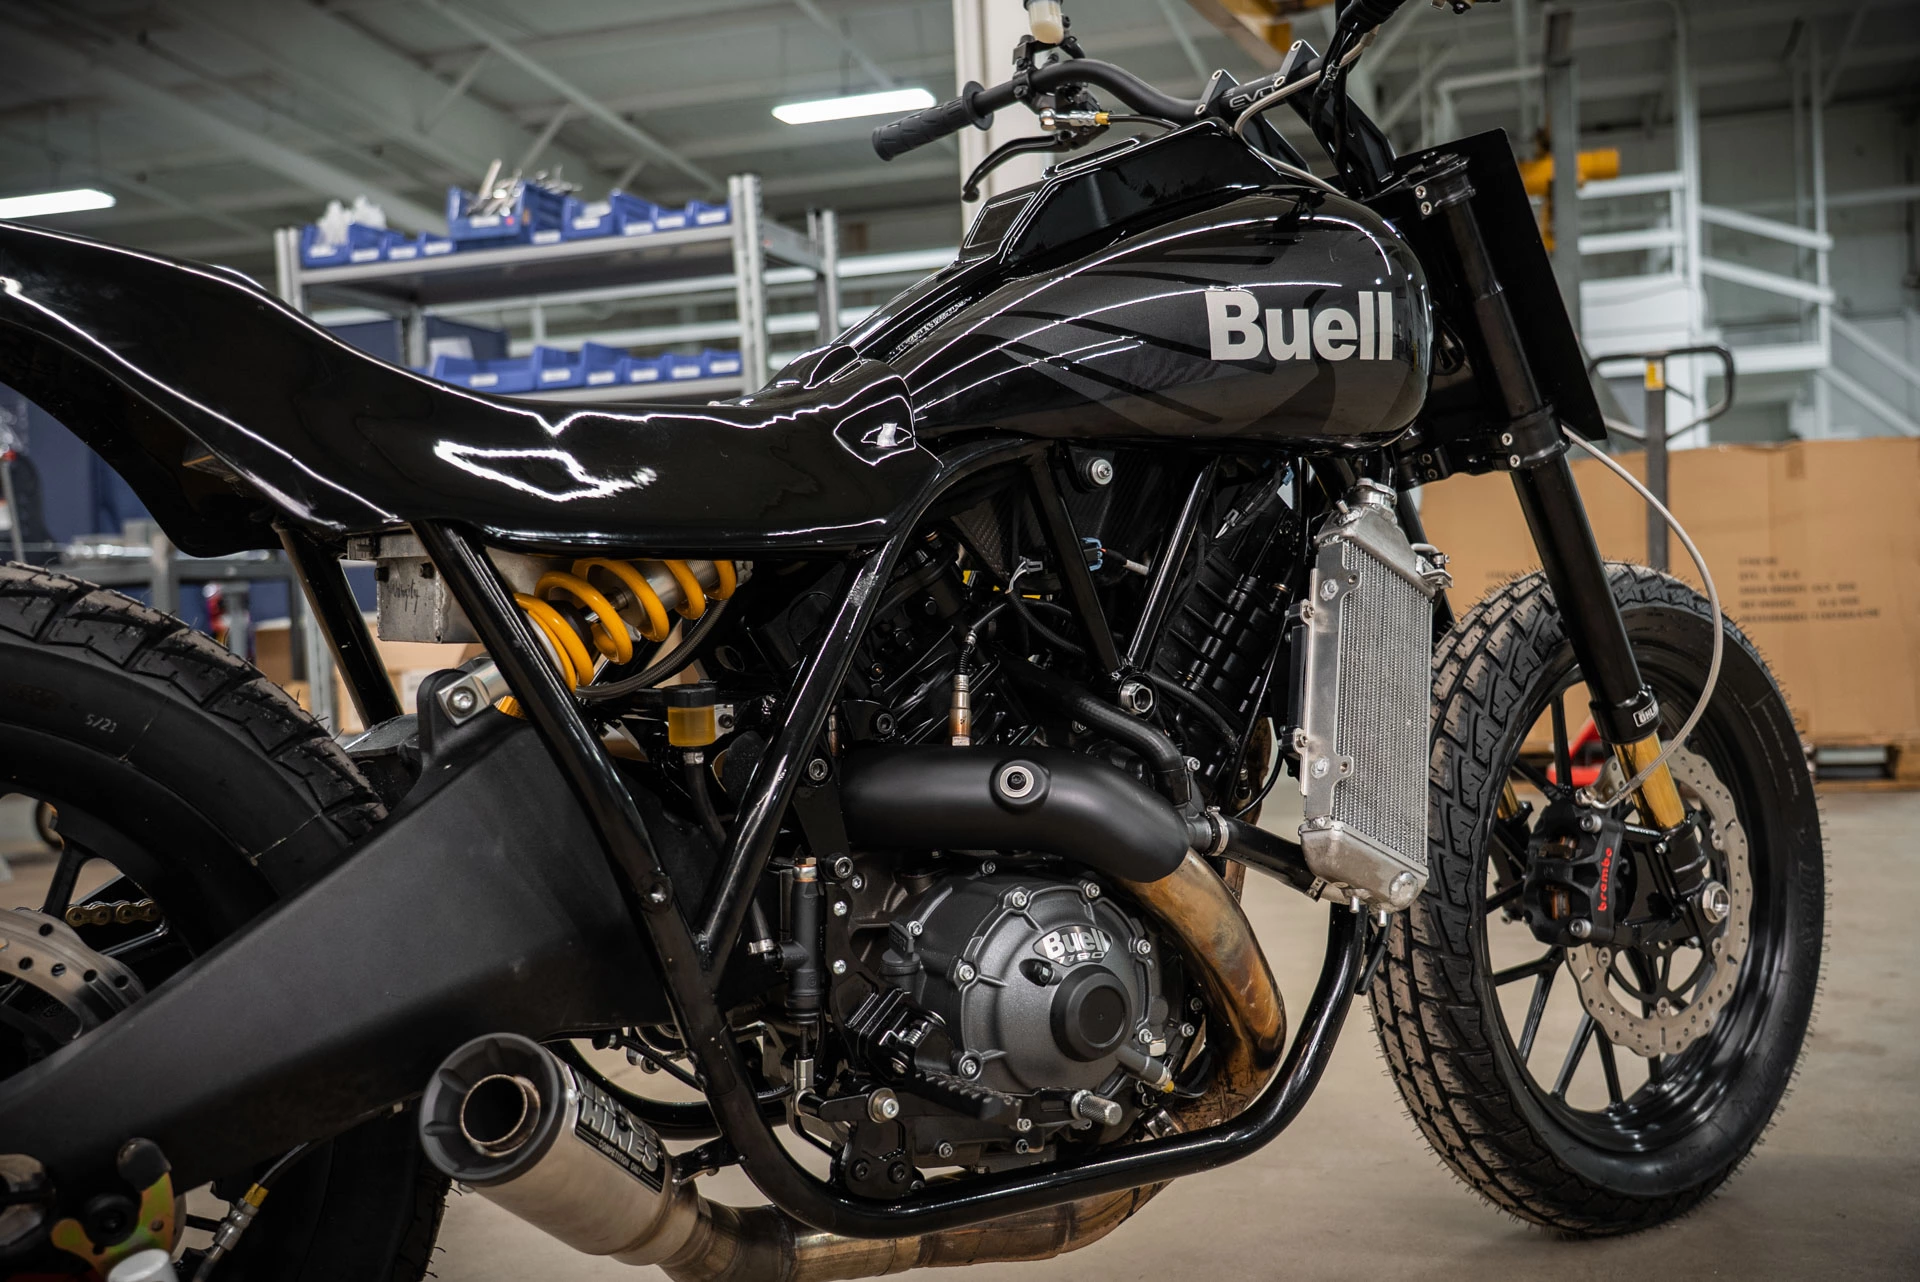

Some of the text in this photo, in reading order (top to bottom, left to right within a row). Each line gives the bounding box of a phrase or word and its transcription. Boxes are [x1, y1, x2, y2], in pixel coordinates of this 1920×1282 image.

[1205, 290, 1393, 361] Buell
[1597, 847, 1613, 912] brembo
[1042, 927, 1110, 960] Buell
[580, 1096, 659, 1172] HINES
[598, 1139, 645, 1176] COMPETITION ONLY
